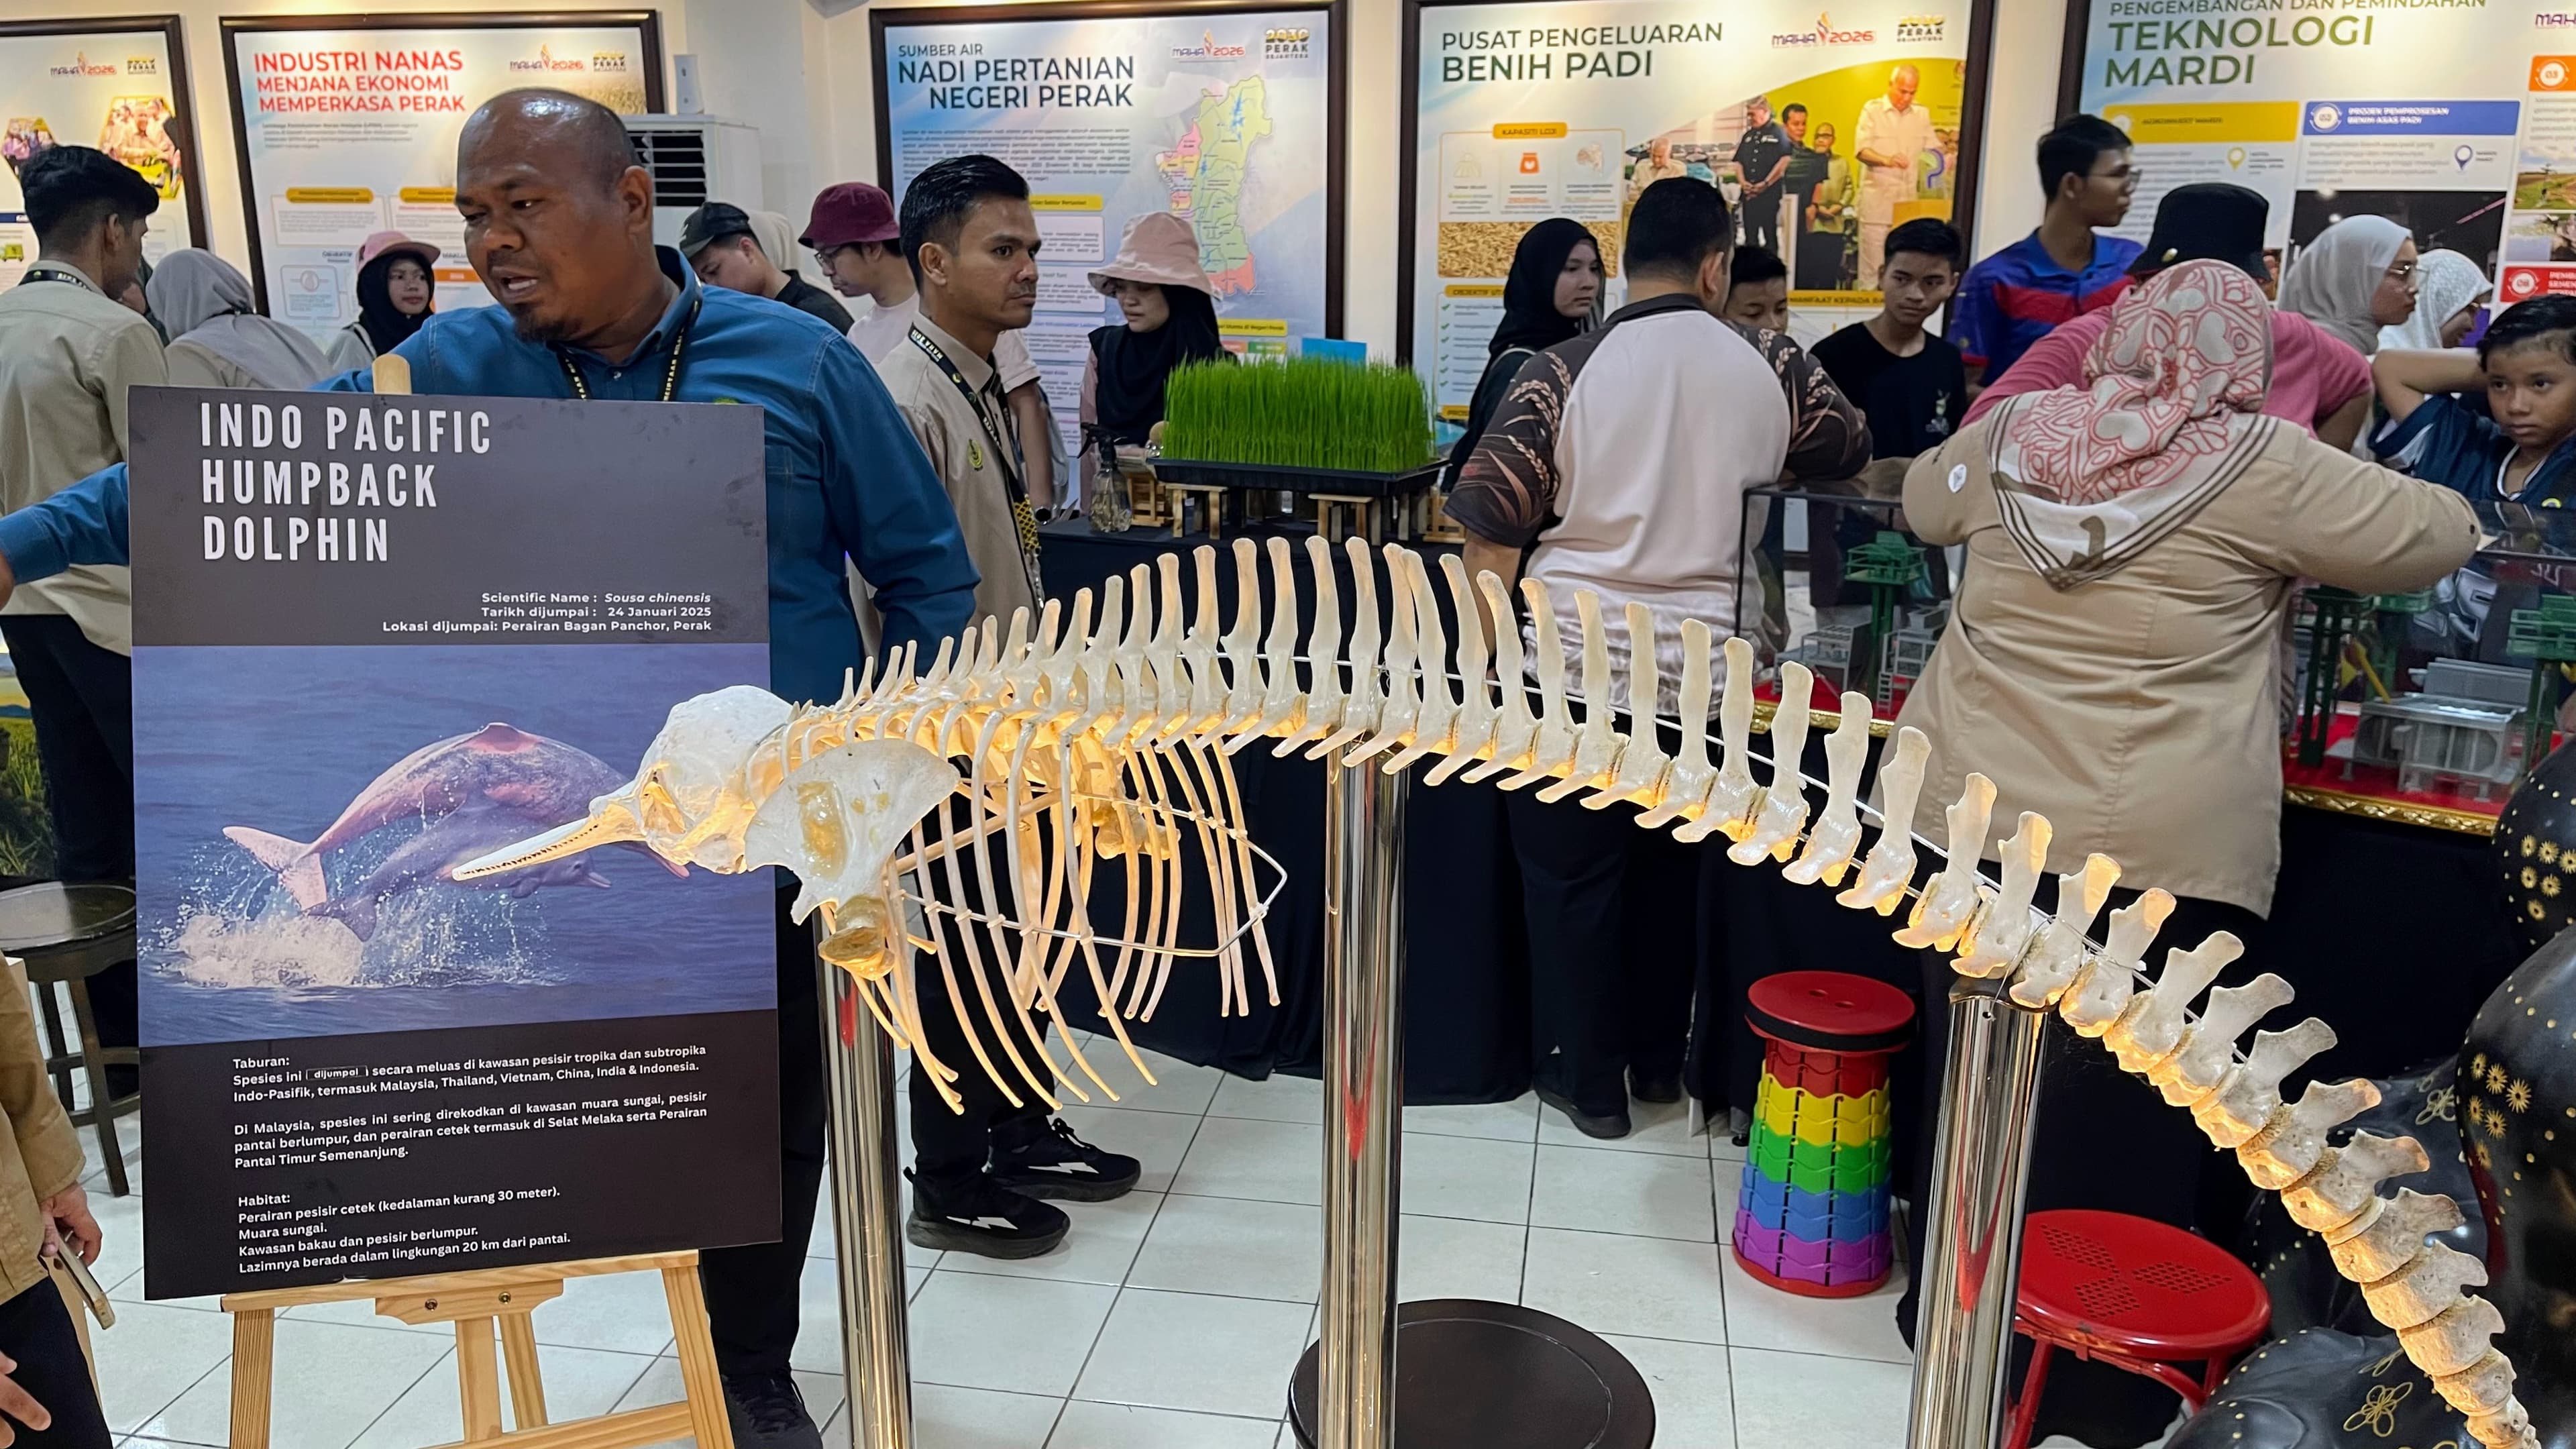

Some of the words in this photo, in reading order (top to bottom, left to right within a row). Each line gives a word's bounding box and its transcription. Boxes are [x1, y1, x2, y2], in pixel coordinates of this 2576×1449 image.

[2110, 0, 2282, 15] PENGEMBANGAN
[2291, 0, 2336, 10] DAN
[2342, 0, 2485, 9] PEMINDAHAN
[1265, 28, 1309, 44] 2030
[1442, 30, 1521, 51] PUSAT
[1529, 23, 1723, 48] PENGELUARAN
[1829, 31, 1874, 43] 2026
[1898, 28, 1943, 36] PERAK
[2108, 16, 2373, 51] TEKNOLOGI
[898, 44, 957, 58] SUMBER
[961, 44, 983, 56] AIR
[1172, 48, 1205, 58] MAHA
[1213, 46, 1246, 57] 2026
[1265, 44, 1309, 53] PERAK
[254, 52, 368, 73] INDUSTRI
[376, 51, 464, 71] NANAS
[898, 58, 967, 84] NADI
[975, 55, 1134, 83] PERTANIAN
[1442, 54, 1551, 83] BENIH
[1565, 50, 1653, 80] PADI
[2104, 55, 2255, 87] MARDI
[257, 76, 350, 93] MENJANA
[355, 74, 450, 93] EKONOMI
[259, 95, 394, 113] MEMPERKASA
[399, 95, 466, 112] PERAK
[929, 83, 1029, 110] NEGERI
[1038, 83, 1134, 108] PERAK
[201, 402, 302, 449] INDO
[326, 407, 490, 454] PACIFIC
[202, 459, 437, 508] HUMPBACK
[203, 515, 388, 561] DOLPHIN
[482, 592, 547, 603] Scientific
[550, 592, 590, 603] Name
[604, 592, 645, 603] Sousa
[648, 592, 711, 603] chinensis
[480, 606, 525, 617] Tarikh
[529, 606, 589, 619] dijumpai
[607, 606, 625, 616] 24
[627, 606, 677, 617] Januari
[680, 606, 712, 616] 2025
[382, 621, 428, 632] Lokasi
[432, 621, 498, 634] dijumpai:
[502, 620, 559, 631] Perairan
[564, 621, 607, 633] Bagan
[610, 621, 669, 632] Panchor,
[674, 620, 712, 631] Perak
[232, 1057, 290, 1069] Taburan:
[233, 1073, 283, 1087] Spesies
[286, 1070, 302, 1082] ini
[314, 1067, 358, 1080] dijumpai
[372, 1065, 414, 1076] secara
[416, 1061, 461, 1073] meluas
[464, 1059, 475, 1070] di
[478, 1058, 529, 1069] kawasan
[533, 1053, 572, 1068] pesisir
[574, 1051, 617, 1064] tropika
[619, 1049, 641, 1060] dan
[644, 1045, 706, 1059] subtropika
[234, 1087, 315, 1102] Indo-Pasifik,
[317, 1082, 377, 1096] termasuk
[380, 1078, 439, 1093] Malaysia,
[441, 1073, 498, 1087] Thailand,
[500, 1072, 553, 1083] Vietnam,
[556, 1068, 594, 1079] China,
[597, 1065, 627, 1077] India
[628, 1065, 637, 1075] &
[639, 1061, 699, 1074] Indonesia.
[234, 1124, 248, 1135] Di
[254, 1120, 315, 1134] Malaysia,
[319, 1116, 367, 1131] spesies
[372, 1113, 388, 1125] ini
[392, 1111, 431, 1124] sering
[436, 1106, 504, 1120] direkodkan
[509, 1104, 521, 1114] di
[526, 1102, 576, 1113] kawasan
[582, 1099, 619, 1110] muara
[623, 1094, 664, 1108] sungai,
[669, 1091, 707, 1106] pesisir
[235, 1138, 276, 1155] pantai
[280, 1135, 350, 1148] berlumpur,
[353, 1132, 377, 1142] dan
[381, 1128, 433, 1143] perairan
[436, 1124, 470, 1136] cetek
[473, 1119, 531, 1133] termasuk
[533, 1118, 545, 1128] di
[548, 1116, 579, 1128] Selat
[582, 1113, 624, 1125] Melaka
[626, 1112, 657, 1122] serta
[659, 1108, 707, 1120] Perairan
[235, 1155, 276, 1169] Pantai
[278, 1153, 317, 1165] Timur
[319, 1146, 409, 1162] Semenanjung.
[238, 1194, 290, 1207] Habitat:
[239, 1210, 292, 1224] Perairan
[295, 1205, 338, 1221] pesisir
[340, 1201, 376, 1215] cetek
[378, 1197, 450, 1212] (kedalaman
[453, 1193, 495, 1205] kurang
[498, 1190, 514, 1201] 30
[517, 1186, 560, 1199] meter).
[239, 1228, 280, 1240] Muara
[282, 1222, 327, 1236] sungai.
[239, 1244, 295, 1256] Kawasan
[298, 1239, 336, 1251] bakau
[339, 1236, 363, 1248] dan
[366, 1231, 408, 1248] pesisir
[411, 1227, 478, 1241] berlumpur.
[239, 1260, 300, 1273] Lazimnya
[303, 1253, 347, 1267] berada
[350, 1250, 389, 1263] dalam
[392, 1245, 460, 1260] lingkungan
[462, 1241, 478, 1252] 20
[482, 1240, 500, 1250] km
[502, 1236, 526, 1248] dari
[529, 1232, 570, 1248] pantai.
